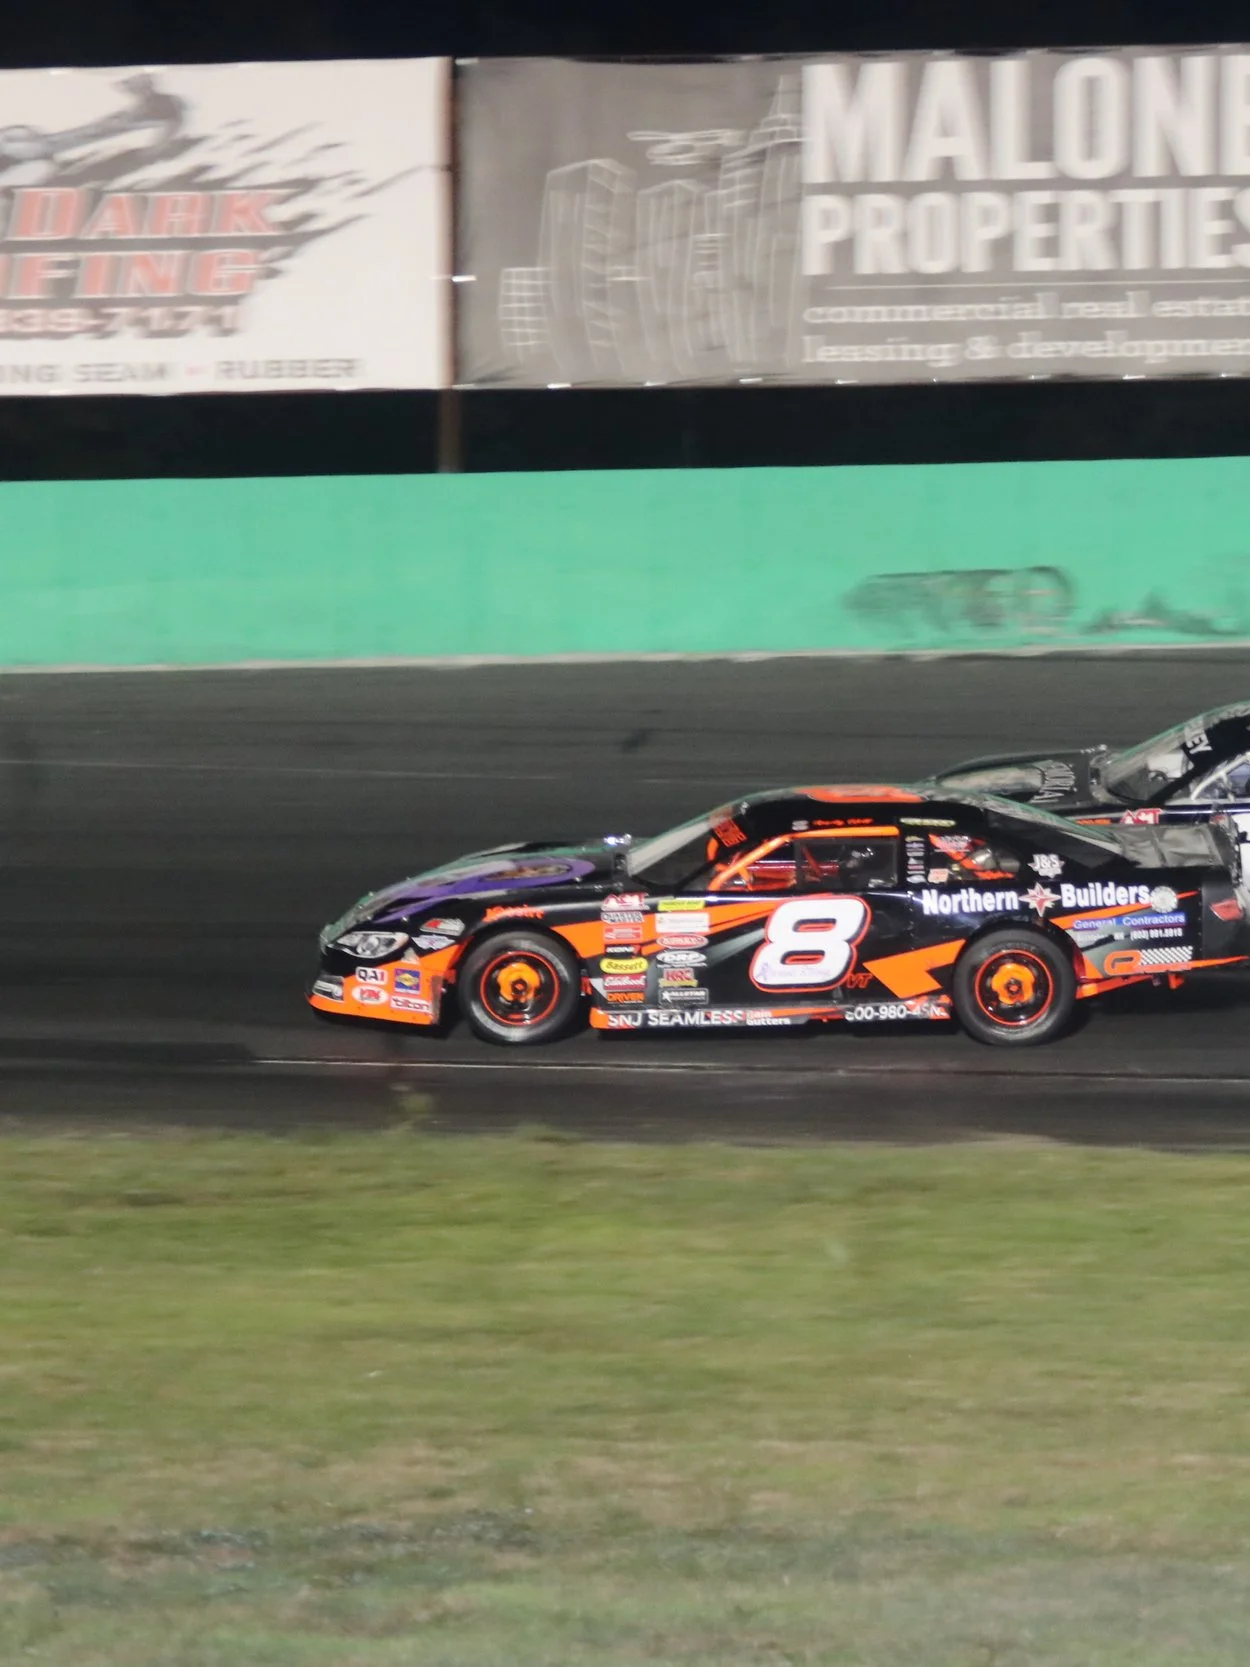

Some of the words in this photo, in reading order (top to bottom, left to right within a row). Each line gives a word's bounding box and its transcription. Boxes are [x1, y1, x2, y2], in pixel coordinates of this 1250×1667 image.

[4, 187, 286, 240] DARK
[0, 249, 258, 299] FING
[803, 292, 1059, 324] commercial
[1061, 291, 1150, 318] real
[802, 334, 962, 367] leasing
[964, 336, 998, 361] &
[216, 357, 360, 379] RUBBER
[922, 888, 1019, 915] Northern
[1059, 881, 1150, 908] Builders
[1073, 918, 1117, 929] General
[1122, 913, 1185, 926] Contractors
[749, 892, 873, 993] 8
[358, 968, 386, 982] QA1
[607, 1013, 643, 1027] SNJ
[647, 1009, 745, 1026] SEAMLESS
